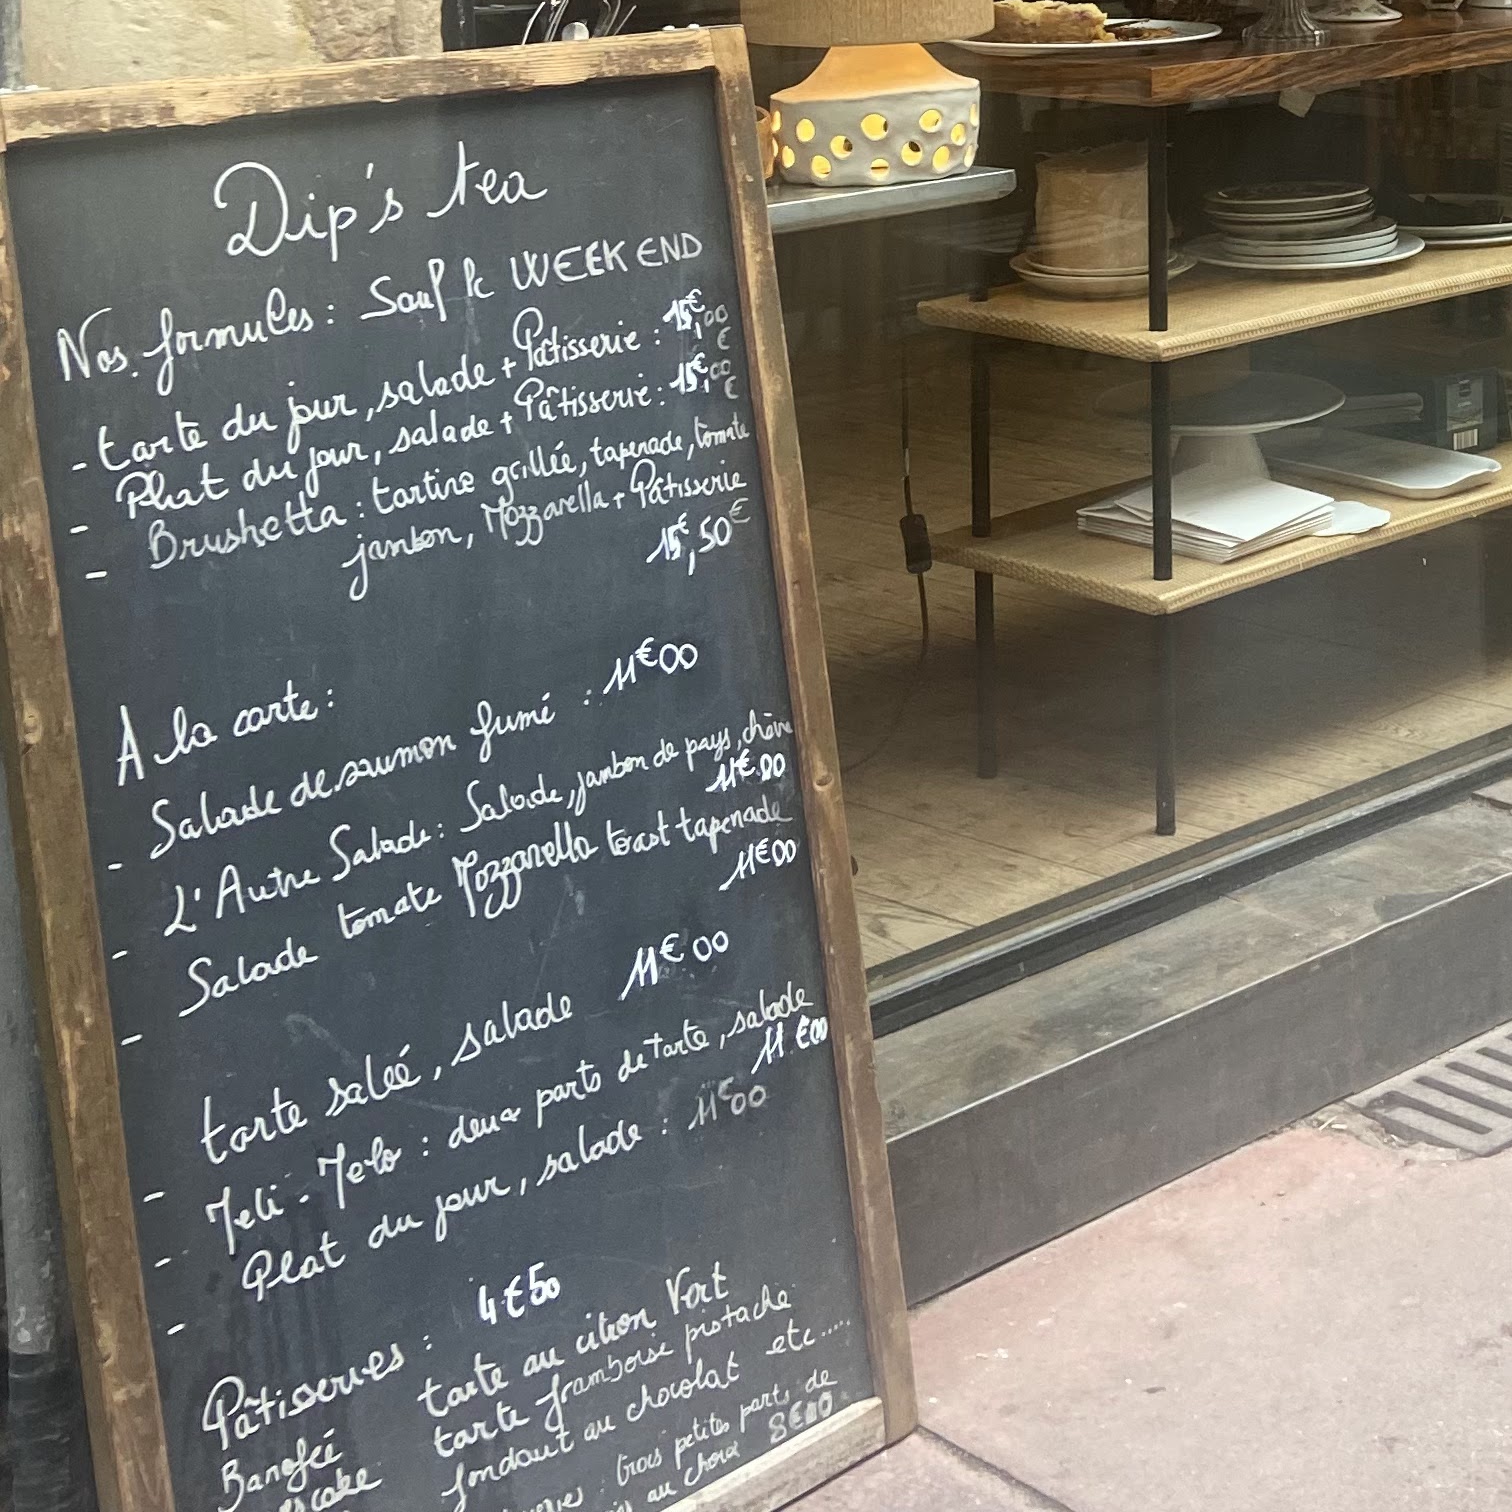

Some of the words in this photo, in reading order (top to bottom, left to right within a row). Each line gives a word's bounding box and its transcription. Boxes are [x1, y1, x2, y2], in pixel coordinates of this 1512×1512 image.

[214, 161, 404, 262] Dip's
[427, 140, 548, 218] tea
[463, 257, 495, 299] le
[510, 239, 629, 290] WEEK
[636, 232, 703, 268] END
[99, 410, 208, 471] tarte
[222, 403, 278, 442] du
[375, 353, 496, 414] salade
[115, 462, 229, 519] Plat
[242, 458, 298, 492] du
[388, 409, 494, 454] salade
[372, 468, 475, 515] tartine
[117, 705, 145, 786] A
[154, 706, 218, 765] la
[150, 790, 282, 860] Salade
[290, 769, 335, 807] de
[333, 734, 457, 792] saumon
[470, 691, 556, 763] fumé
[653, 738, 679, 769] de
[179, 937, 318, 1017] Salade
[338, 881, 442, 939] tomate
[606, 810, 672, 857] toast
[673, 794, 795, 855] tapenade
[201, 1087, 307, 1164] tarte
[451, 992, 573, 1068] salade
[618, 1049, 649, 1082] de
[727, 981, 814, 1039] salade
[242, 1231, 346, 1302] Plat
[367, 1215, 424, 1249] du
[536, 1119, 643, 1187] salade
[416, 1352, 509, 1418] tarte
[523, 1346, 565, 1377] au
[576, 1307, 657, 1355] citron
[434, 1401, 530, 1458] tarte
[535, 1332, 674, 1433] framboise
[584, 1415, 616, 1441] au
[626, 1351, 739, 1422] chocolat
[805, 1369, 838, 1393] de
[647, 1482, 677, 1504] au
